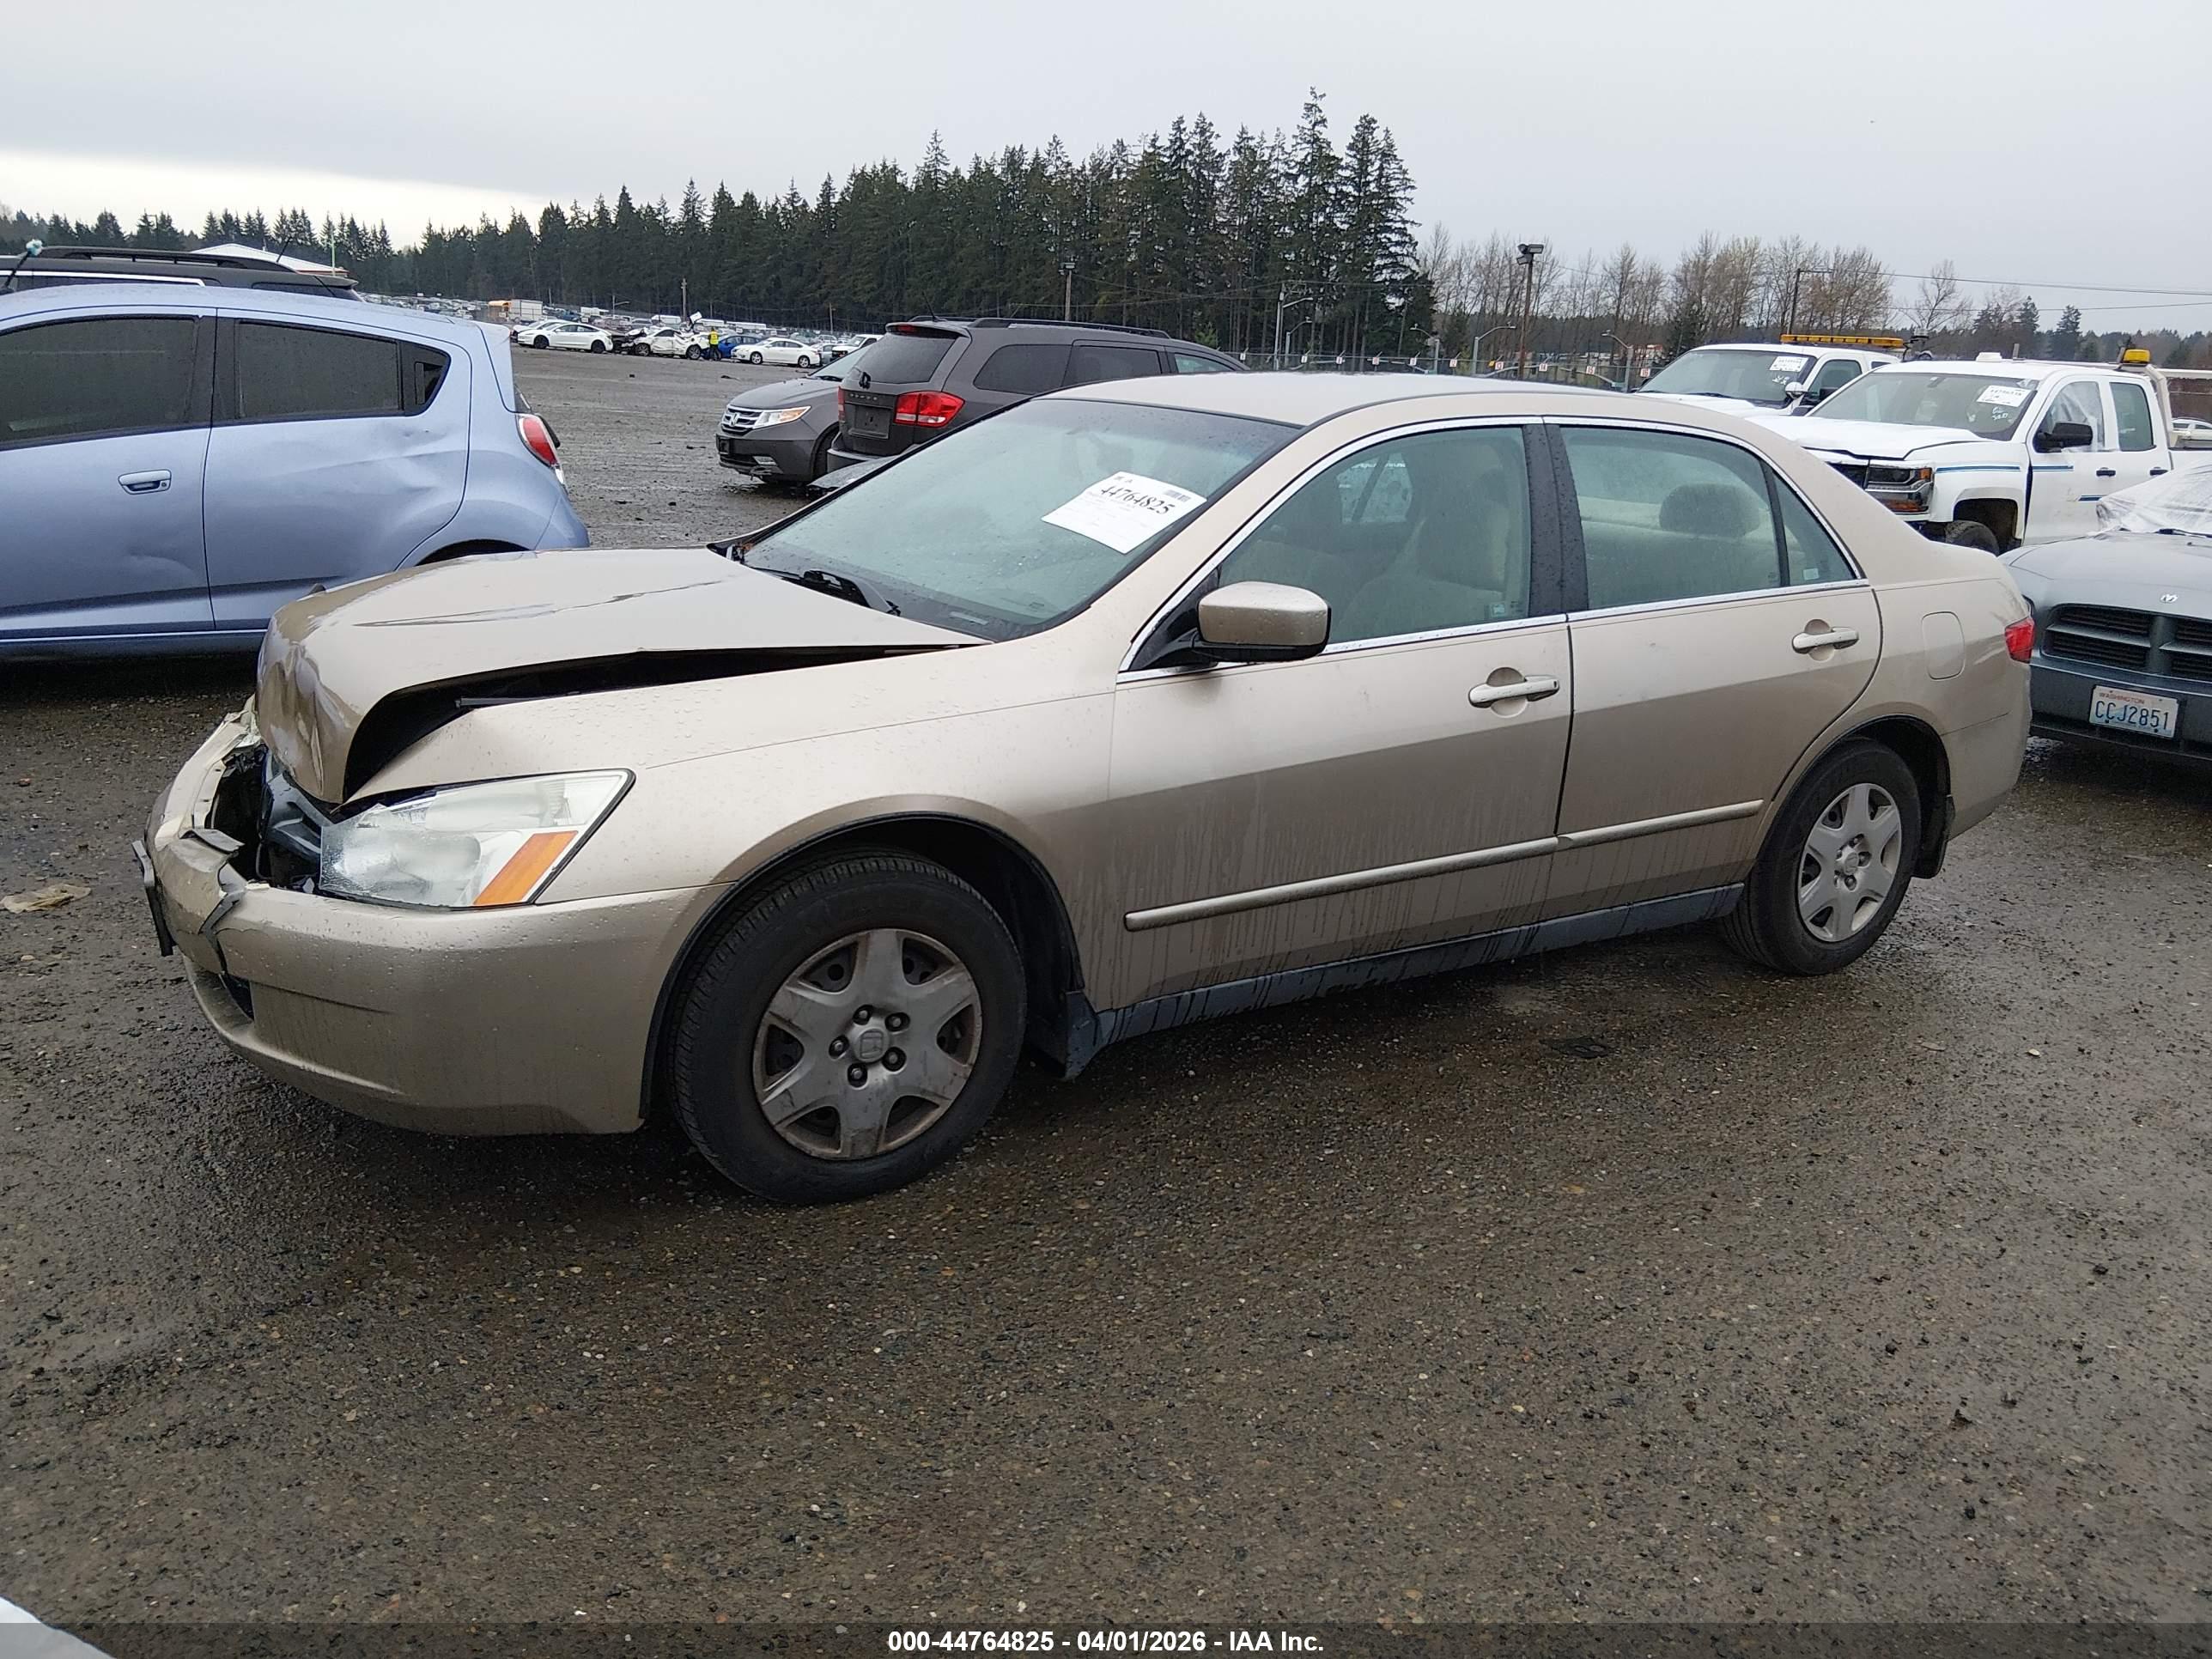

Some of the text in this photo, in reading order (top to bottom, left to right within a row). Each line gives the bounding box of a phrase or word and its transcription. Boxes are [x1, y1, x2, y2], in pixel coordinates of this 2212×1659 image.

[1101, 485, 1176, 514] 44764825
[2099, 692, 2145, 704] WASHINGTON
[2095, 700, 2169, 730] CCJ2851
